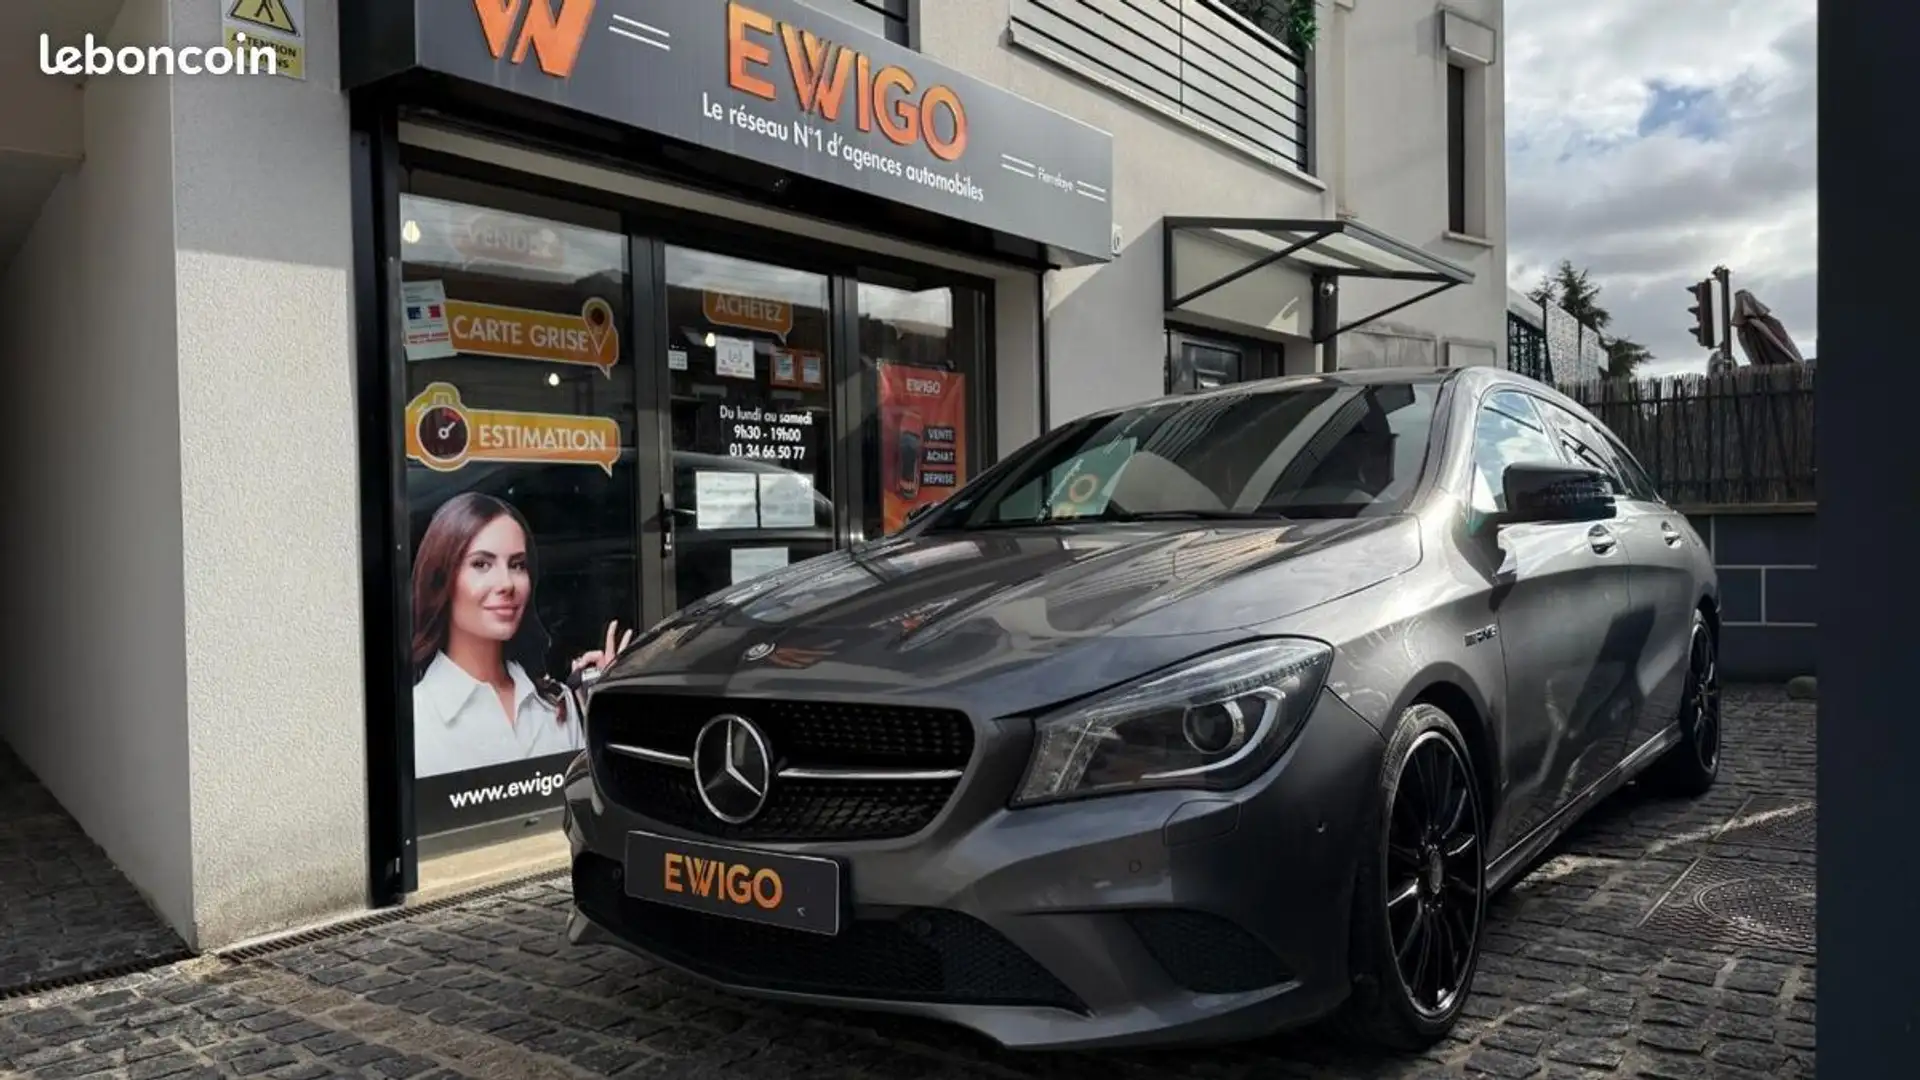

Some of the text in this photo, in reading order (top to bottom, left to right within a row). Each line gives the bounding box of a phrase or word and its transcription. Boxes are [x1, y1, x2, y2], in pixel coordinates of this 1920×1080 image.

[231, 32, 297, 58] ATENTION
[727, 2, 968, 161] EWIGO
[702, 92, 723, 122] Le
[728, 102, 789, 142] réseau
[827, 134, 902, 178] d'agences
[906, 166, 984, 202] automobiles
[715, 293, 784, 322] ACHETEZ
[453, 315, 589, 352] CARTE GRISE
[906, 378, 941, 394] EWIGO
[720, 404, 813, 425] Du lundi au samedi
[478, 424, 606, 451] ESTIMATION
[733, 424, 761, 440] 9h30
[771, 426, 801, 442] 19h00
[729, 442, 806, 460] 01 34 66 50 77
[664, 852, 784, 909] EWIGO
